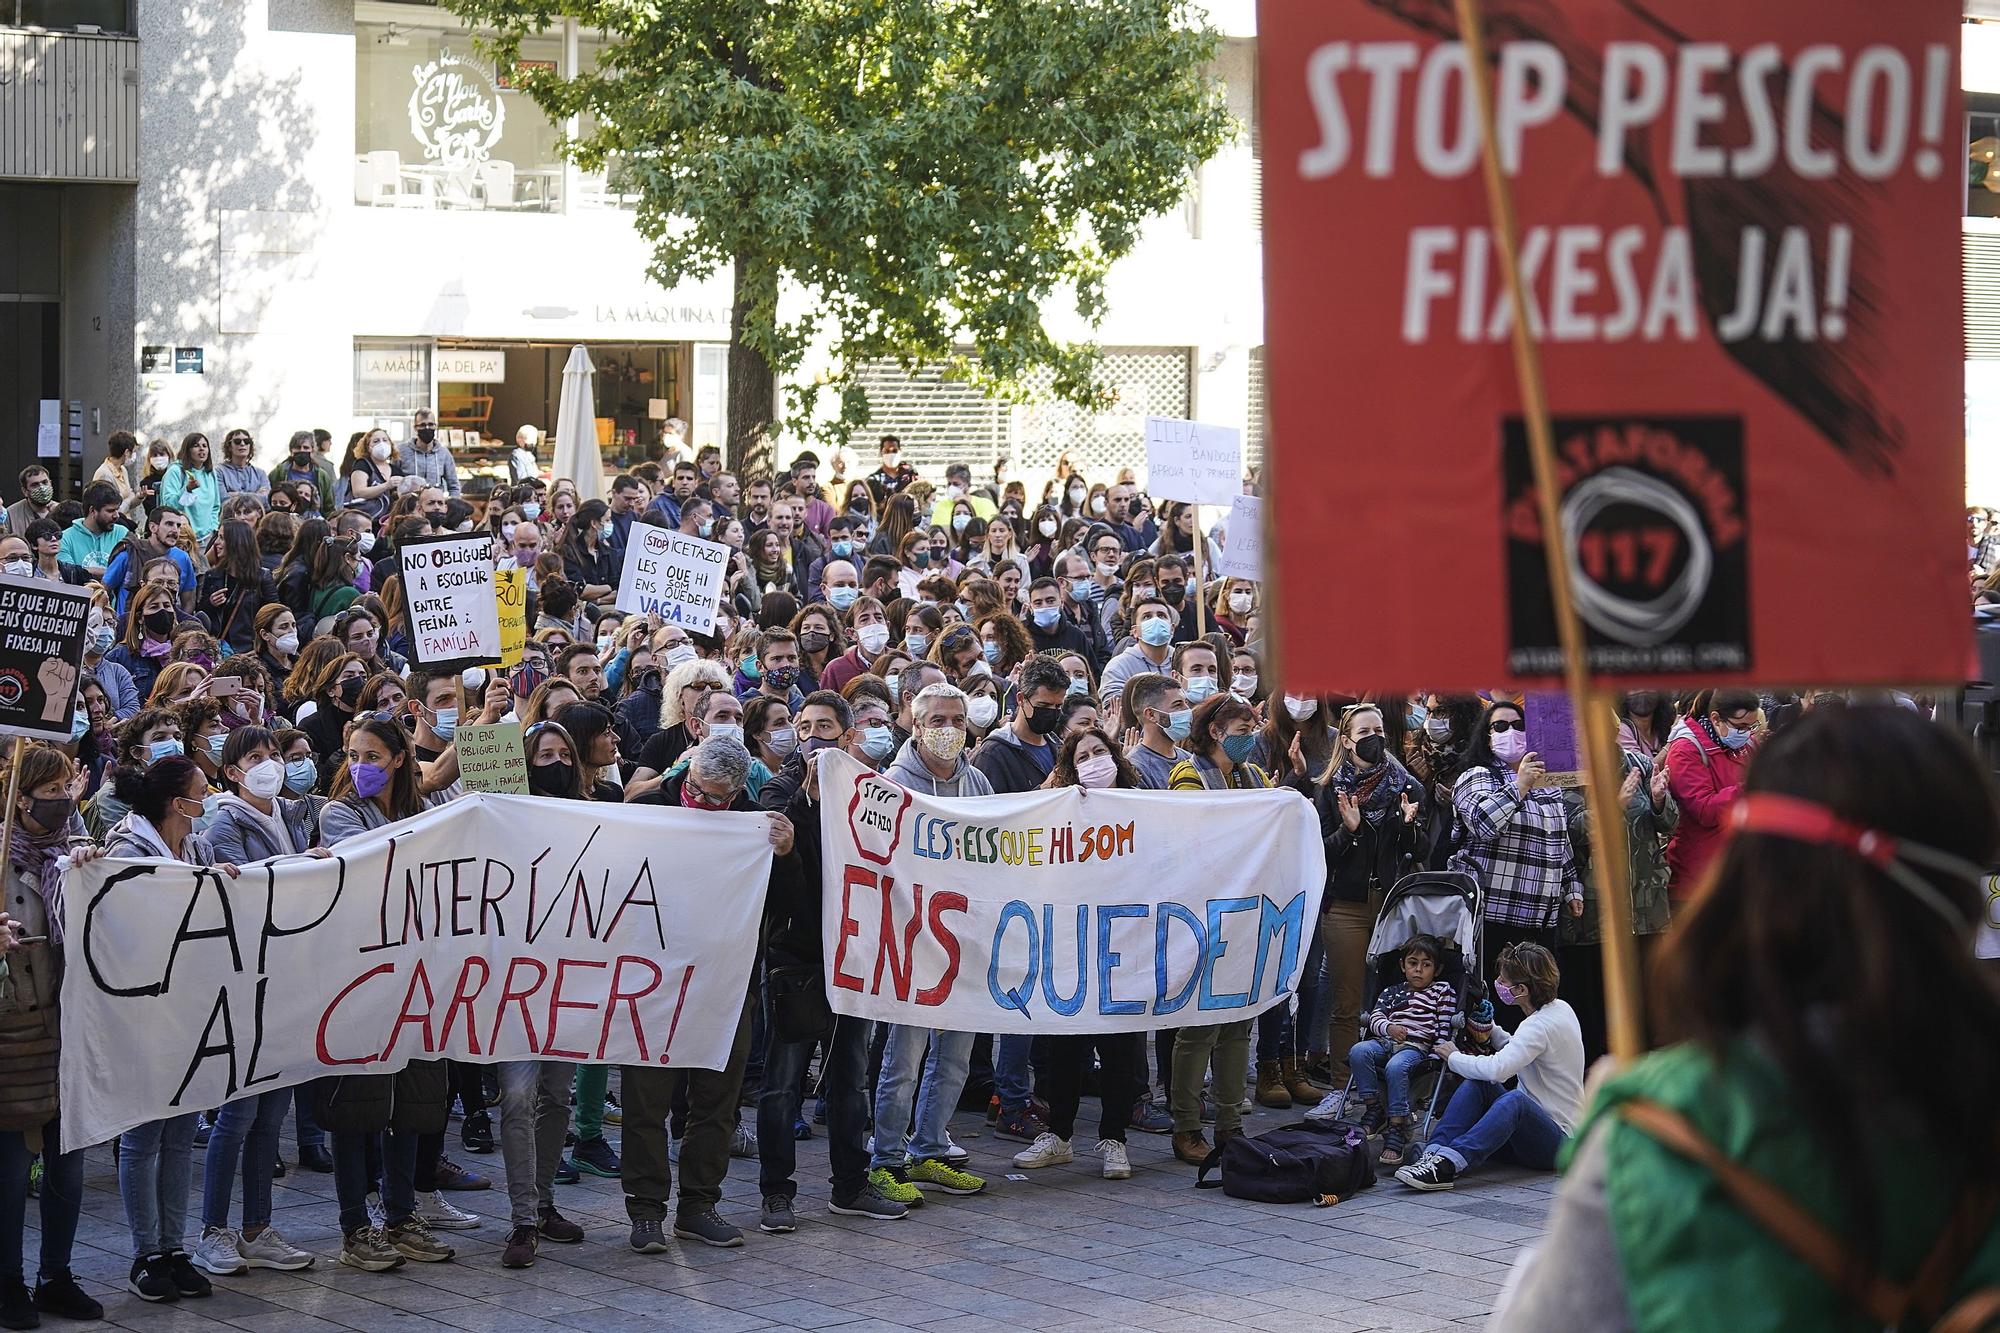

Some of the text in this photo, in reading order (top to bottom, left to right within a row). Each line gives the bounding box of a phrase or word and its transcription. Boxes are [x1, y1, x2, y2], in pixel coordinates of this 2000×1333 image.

[1299, 42, 1950, 179] STOP PESCO!
[1402, 224, 1854, 342] FIXESA JA!
[92, 316, 101, 331] 12
[595, 304, 616, 324] LA
[455, 360, 475, 374] DEL
[646, 535, 669, 550] STOP
[404, 553, 427, 571] NO
[637, 558, 657, 574] LES
[1580, 528, 1677, 587] 117
[420, 576, 428, 591] A
[635, 578, 657, 594] ENS
[666, 580, 690, 591] SOM
[17, 593, 45, 614] QUE
[45, 597, 60, 615] HI
[60, 599, 86, 620] SOM
[413, 596, 454, 613] ENTRE
[640, 595, 682, 623] VAGA
[685, 614, 697, 625] 28
[22, 612, 79, 637] QUEDEM!
[5, 633, 62, 656] FIXESA JA!
[460, 730, 495, 742] NO ENS
[461, 742, 515, 757] OBLIGUEU A
[466, 779, 492, 790] FEINA
[863, 782, 898, 804] STOP
[913, 812, 959, 861] LES
[963, 825, 999, 864] ELS
[999, 828, 1044, 866] QUE
[1049, 821, 1075, 865] HI
[1077, 820, 1135, 863] SOM
[83, 854, 346, 998] CAP
[832, 863, 1307, 1021] ENS QUEDEM
[169, 956, 695, 1107] AL CARRER!
